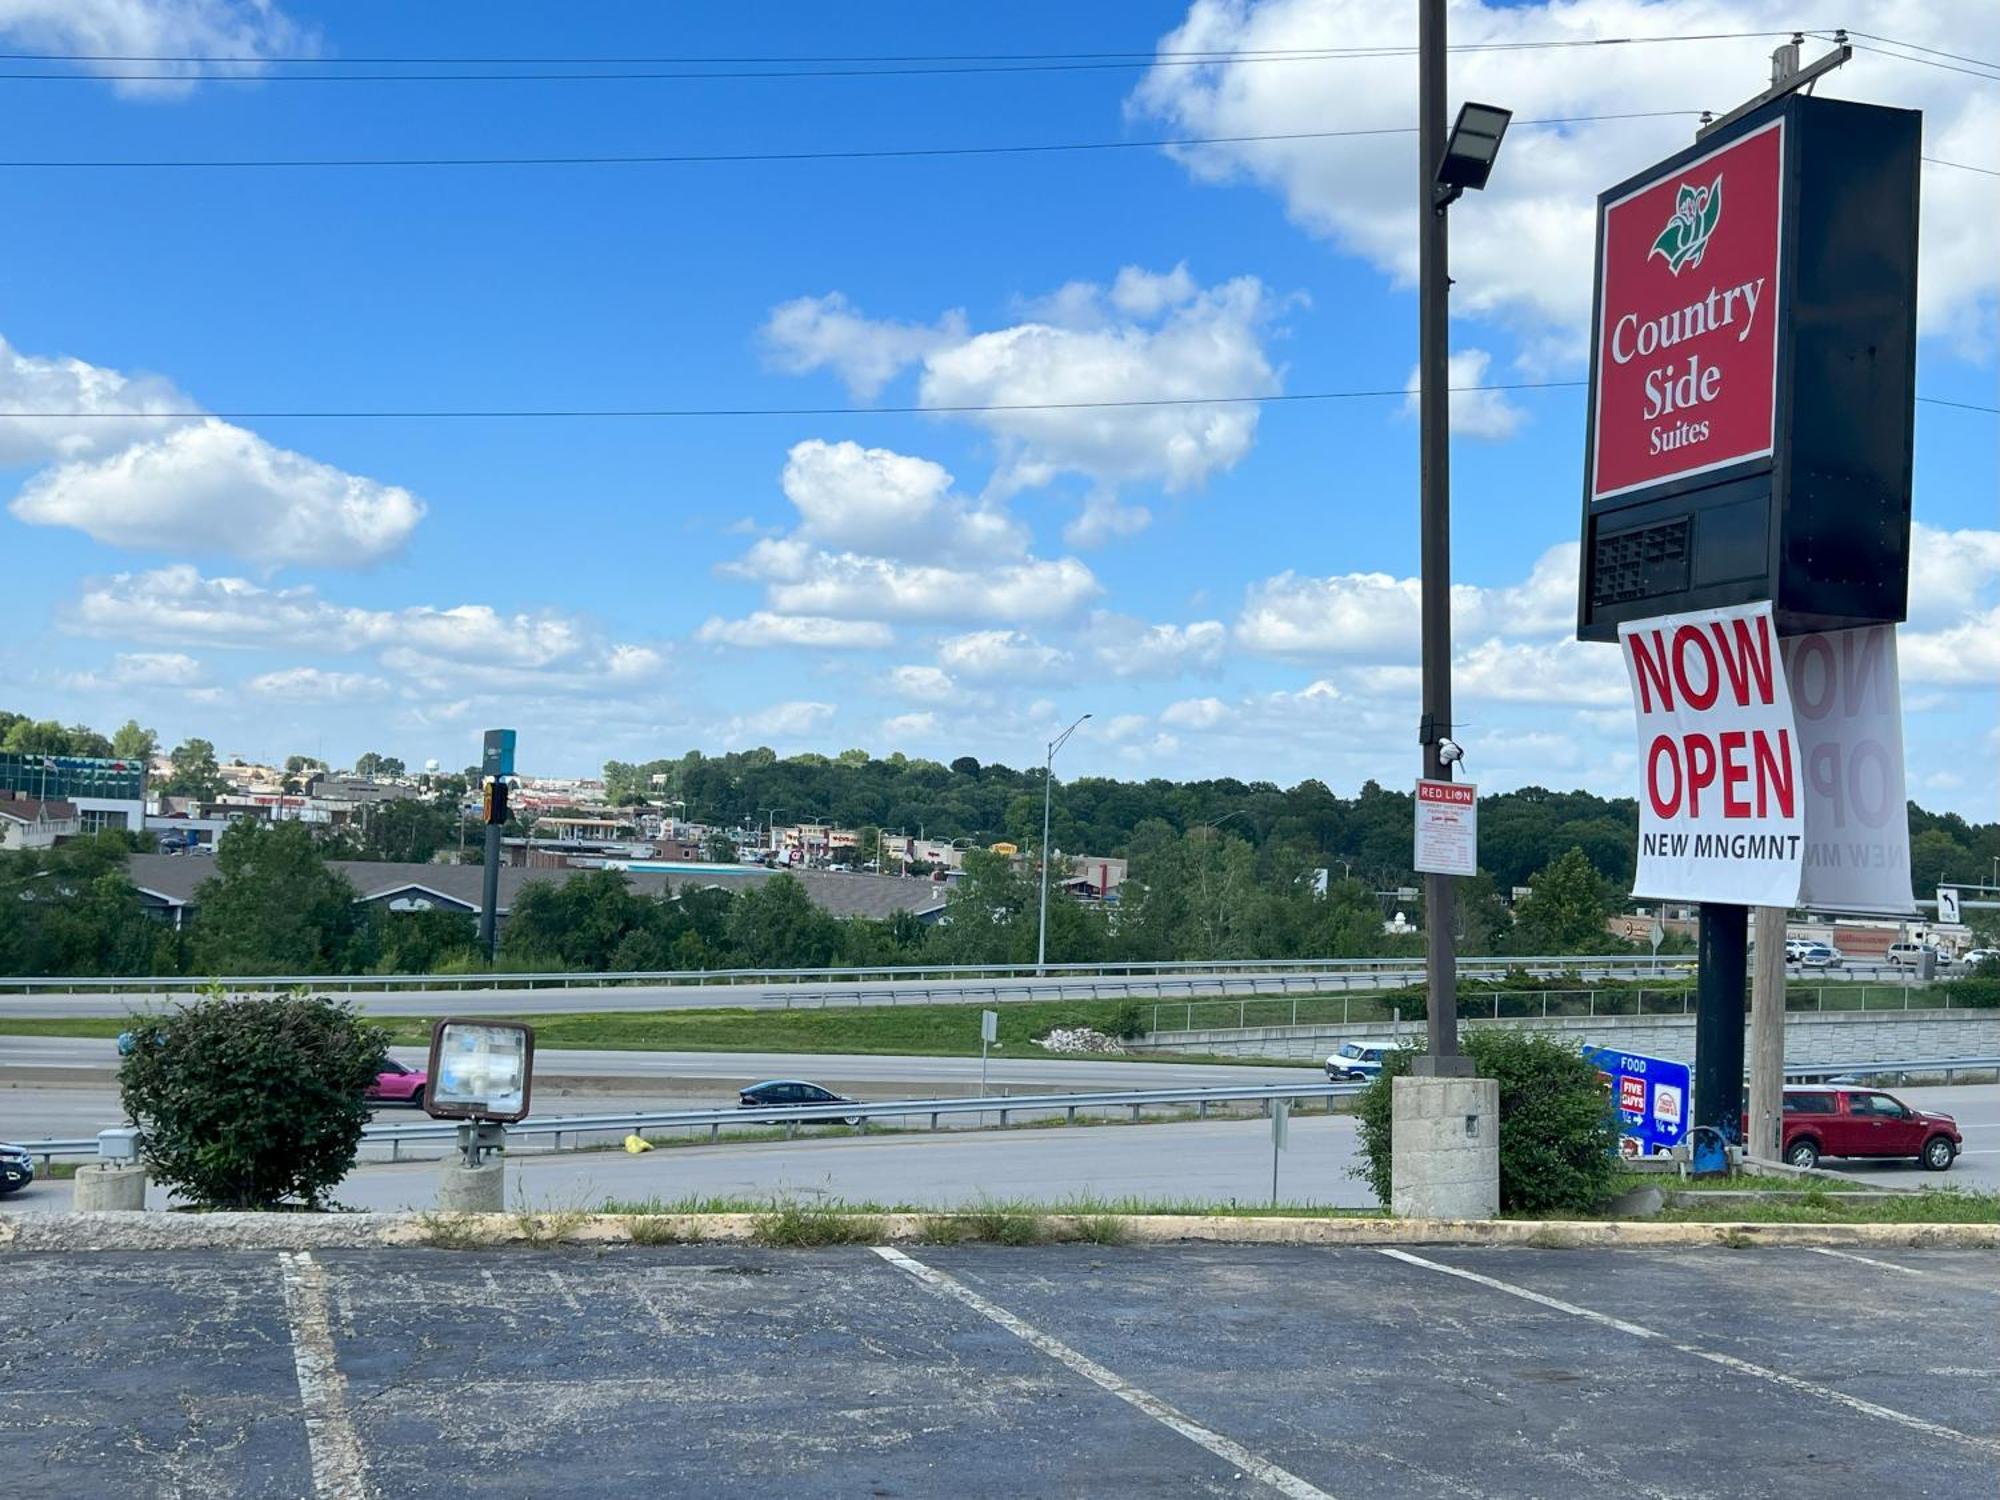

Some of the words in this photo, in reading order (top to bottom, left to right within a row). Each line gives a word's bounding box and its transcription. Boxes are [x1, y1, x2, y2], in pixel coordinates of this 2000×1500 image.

[1612, 277, 1765, 366] Country
[1643, 356, 1722, 421] Side
[1650, 420, 1710, 456] Suites
[1628, 615, 1774, 714] NOW
[1648, 729, 1795, 820] OPEN
[1421, 786, 1443, 798] RED
[1445, 789, 1471, 801] LION
[1643, 833, 1689, 858] NEW
[1694, 833, 1801, 860] MNGMNT
[1621, 1057, 1646, 1073] FOOD
[1622, 1095, 1644, 1108] GUYS
[1624, 1082, 1642, 1095] FIVE
